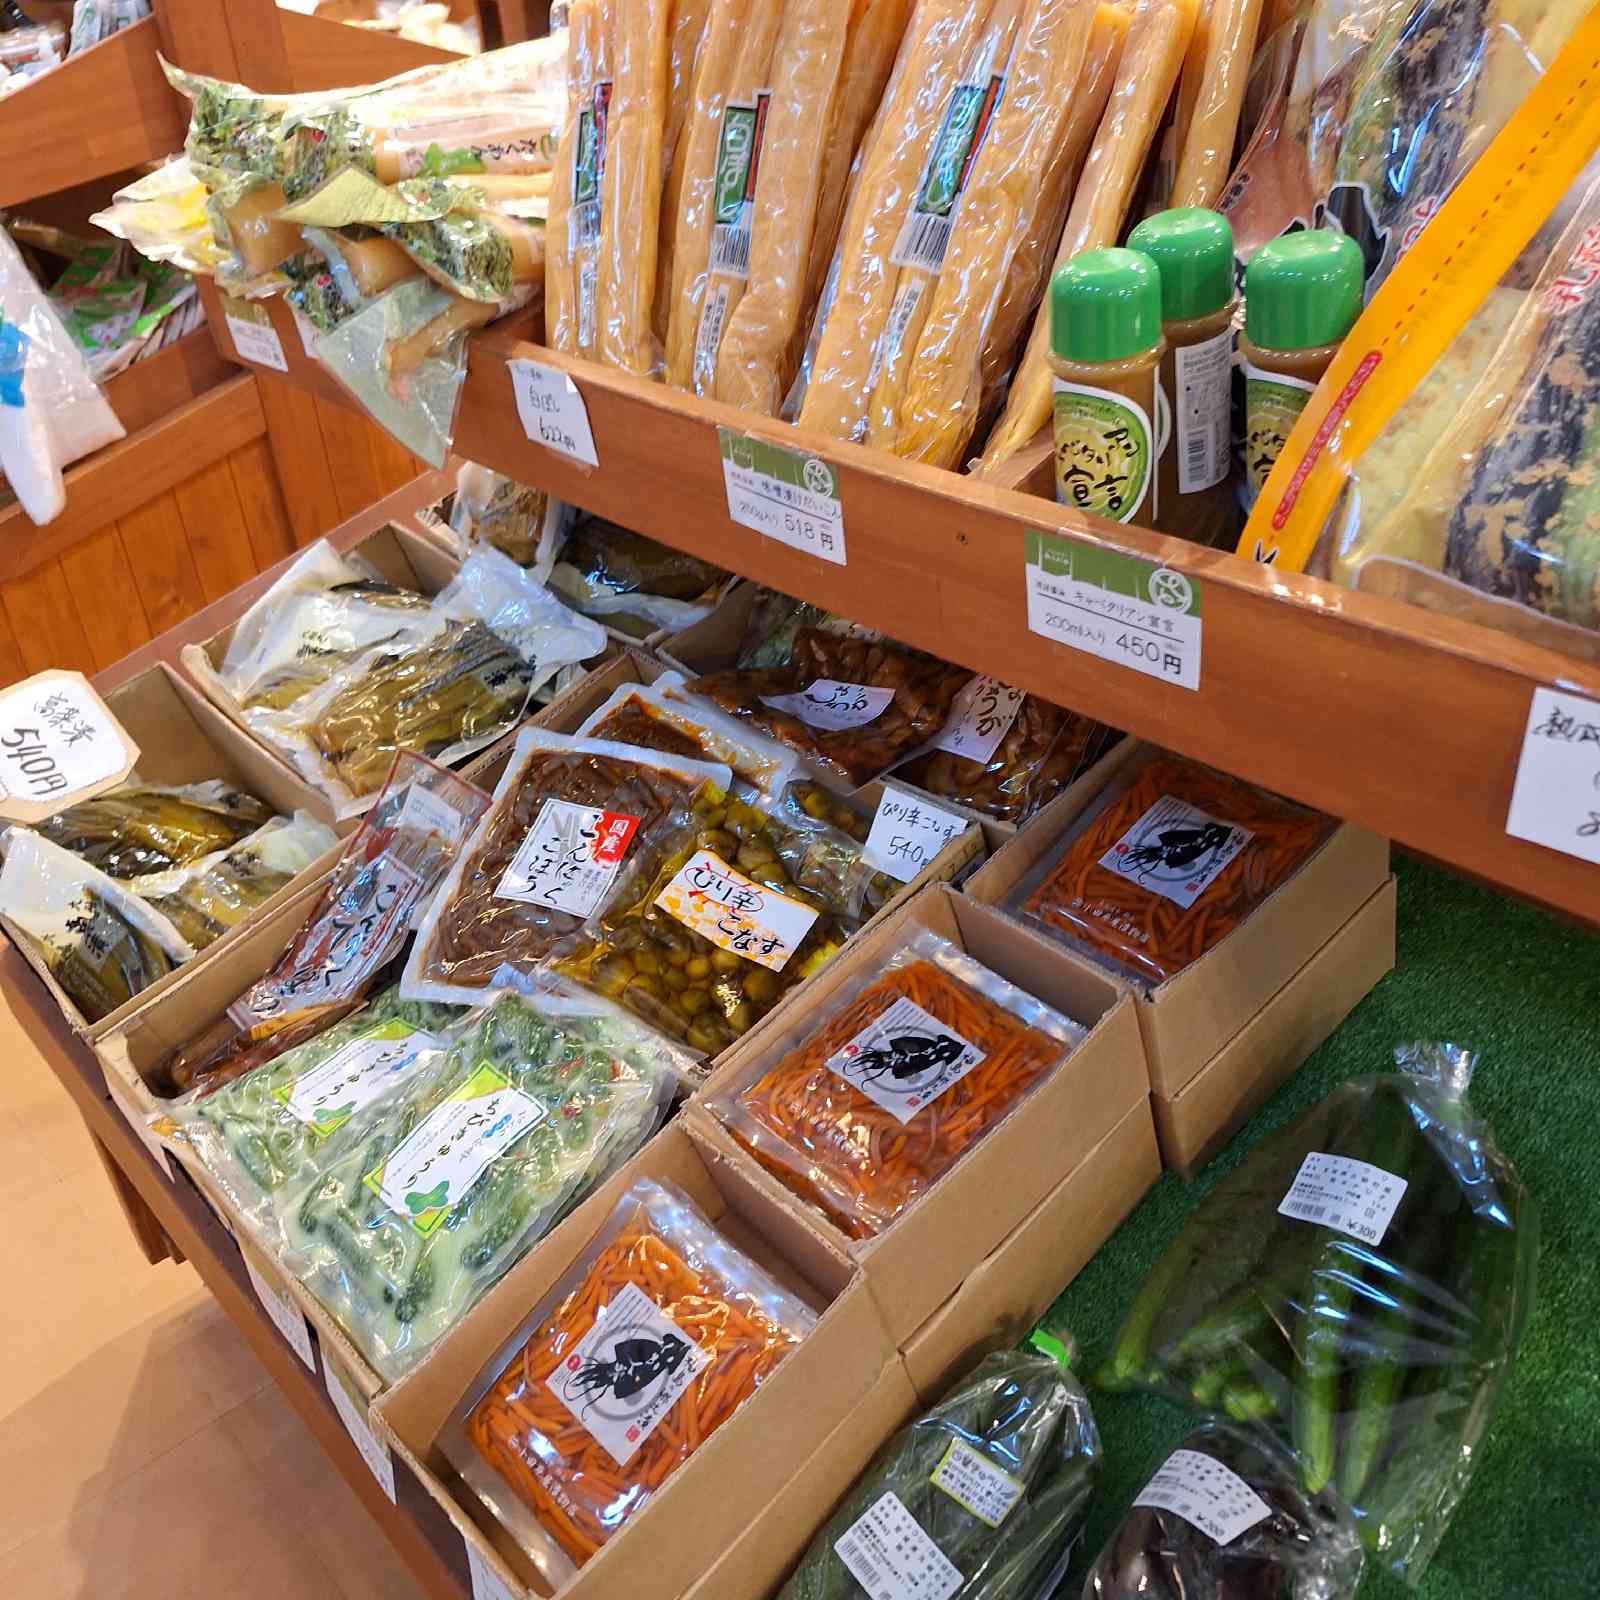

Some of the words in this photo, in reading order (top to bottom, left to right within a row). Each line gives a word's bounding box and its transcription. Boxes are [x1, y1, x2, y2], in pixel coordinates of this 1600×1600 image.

[783, 512, 833, 551] 518円
[1114, 632, 1182, 675] 450円
[1, 728, 69, 797] 540円
[692, 867, 756, 910] ぴり辛
[717, 913, 785, 955] こなす
